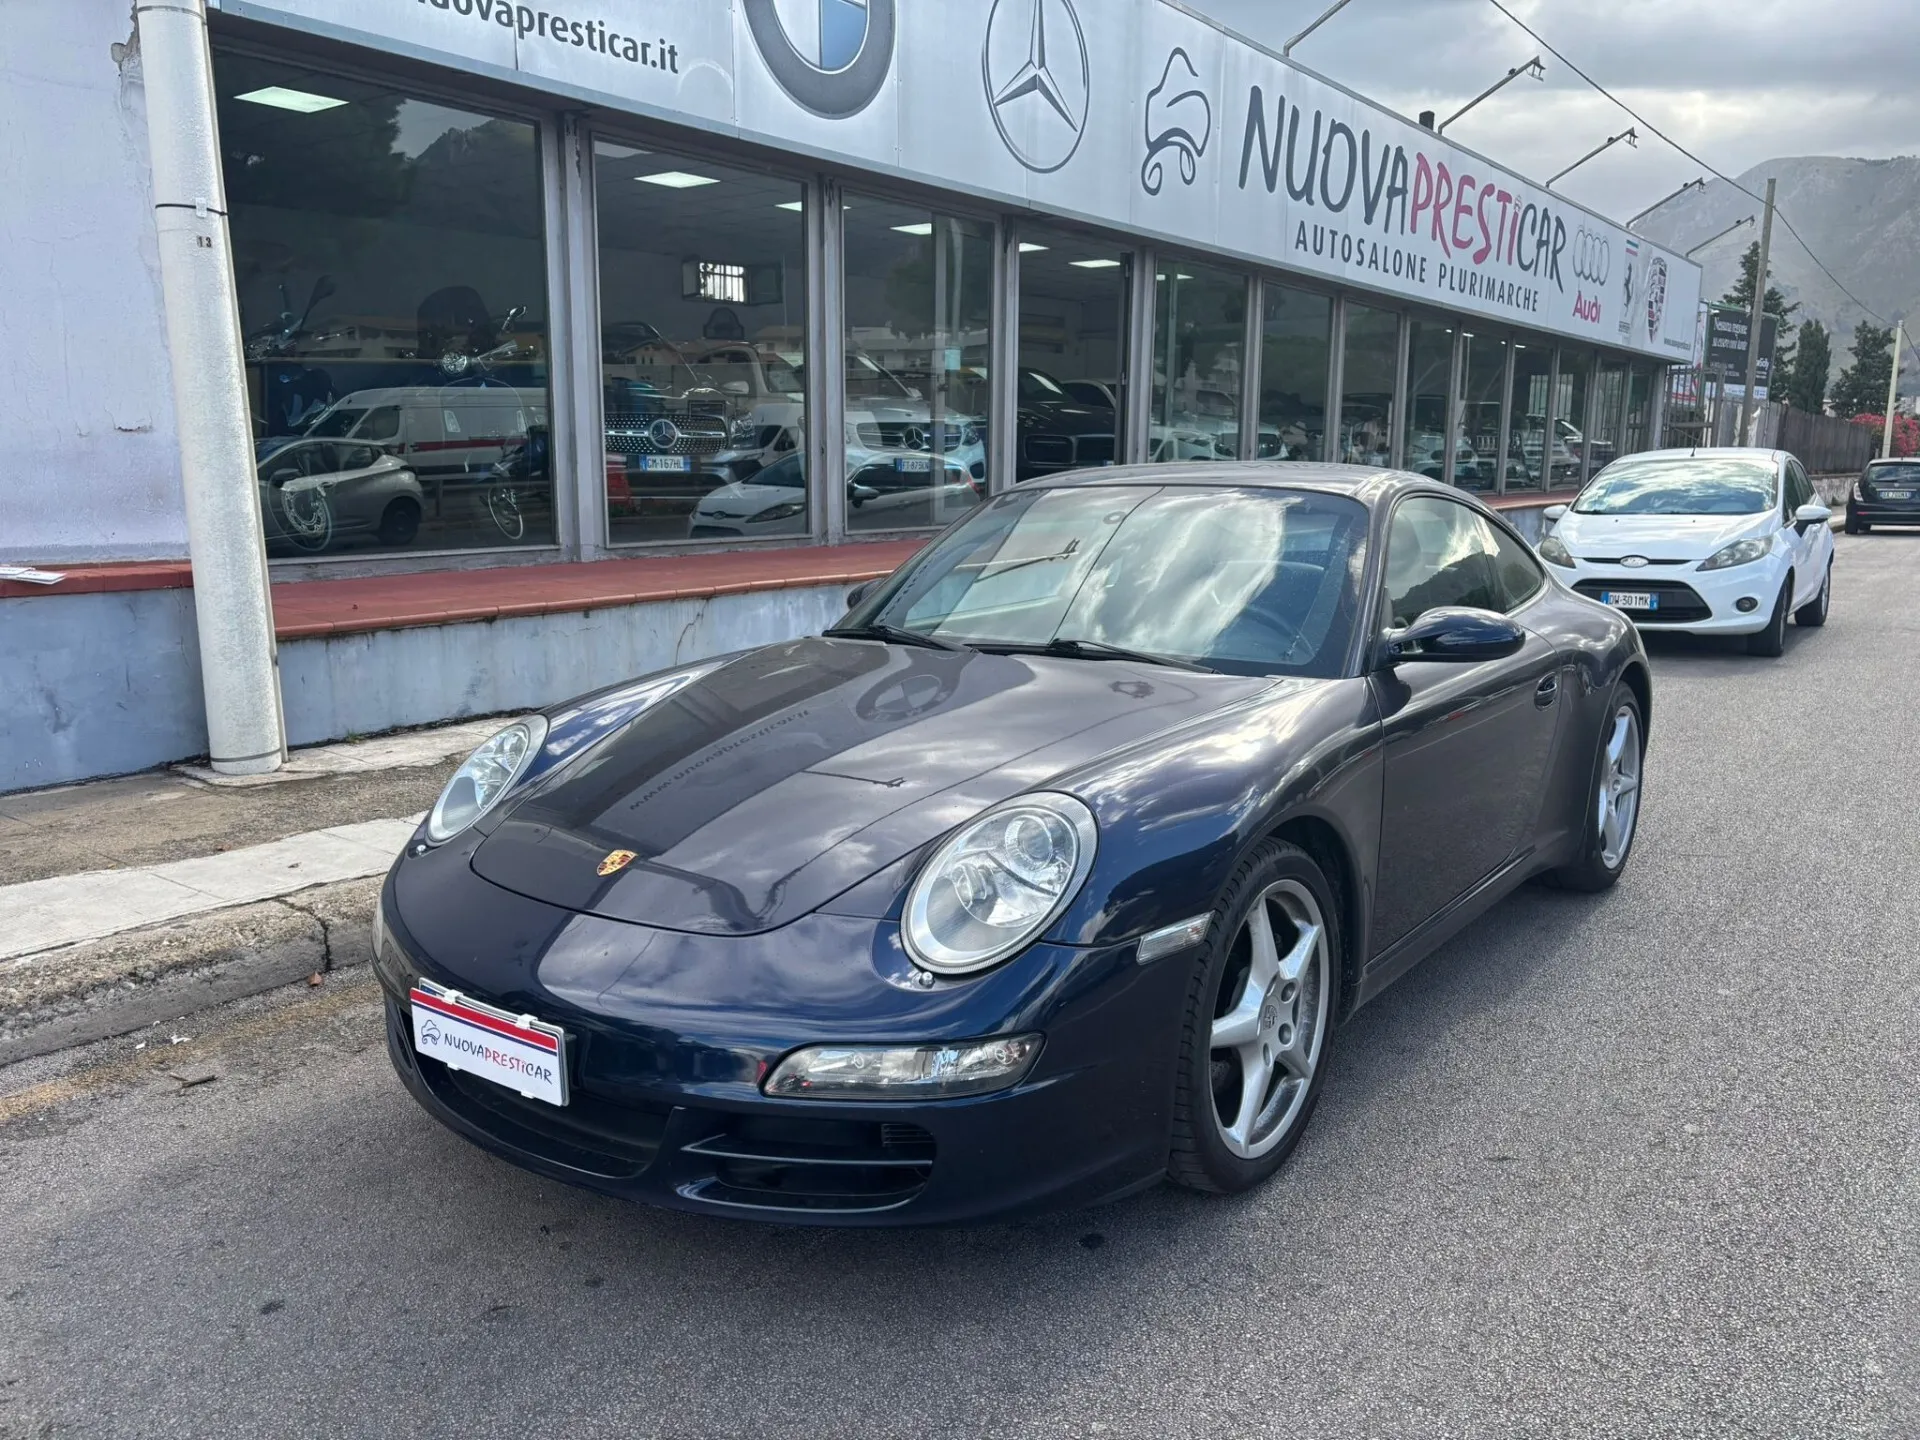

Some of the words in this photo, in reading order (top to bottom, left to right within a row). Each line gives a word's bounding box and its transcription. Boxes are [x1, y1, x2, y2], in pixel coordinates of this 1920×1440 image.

[418, 0, 679, 74] ovapresticar.it
[1295, 219, 1427, 284] AUTOSALONE
[1438, 262, 1539, 312] PLURIMARCHE
[1572, 290, 1602, 324] Audi
